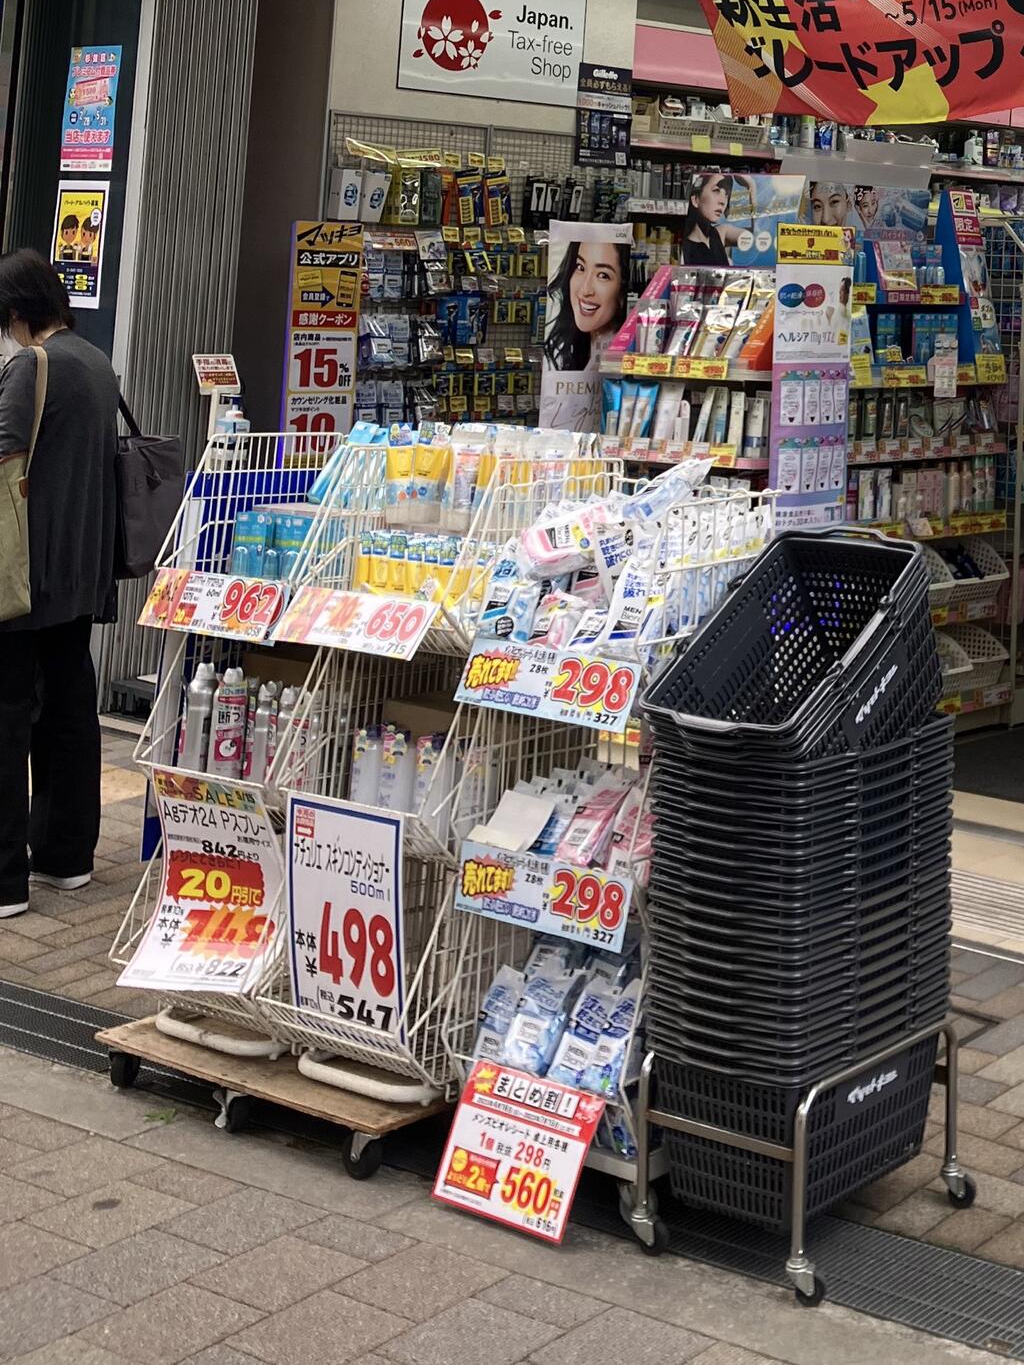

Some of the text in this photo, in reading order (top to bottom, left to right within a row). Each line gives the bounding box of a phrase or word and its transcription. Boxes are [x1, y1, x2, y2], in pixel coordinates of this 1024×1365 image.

[516, 5, 574, 31] Japan.
[507, 29, 573, 56] Tax-free
[530, 56, 572, 82] Shop
[297, 223, 362, 247] マツキヨ
[300, 251, 360, 266] 公式アプリ
[299, 312, 352, 326] 感謝クーポン
[778, 332, 809, 343] ヘルシア
[294, 348, 338, 388] 15
[338, 375, 351, 388] OFF
[290, 396, 347, 405] カウンセリング化粧品
[289, 413, 336, 455] 10
[221, 579, 280, 626] 962
[365, 599, 426, 644] 650
[552, 657, 635, 713] 298
[593, 713, 618, 726] 327
[192, 786, 237, 808] SALE
[551, 869, 626, 931] 298
[319, 901, 396, 998] 498
[592, 930, 614, 944] 327
[336, 994, 394, 1032] 547
